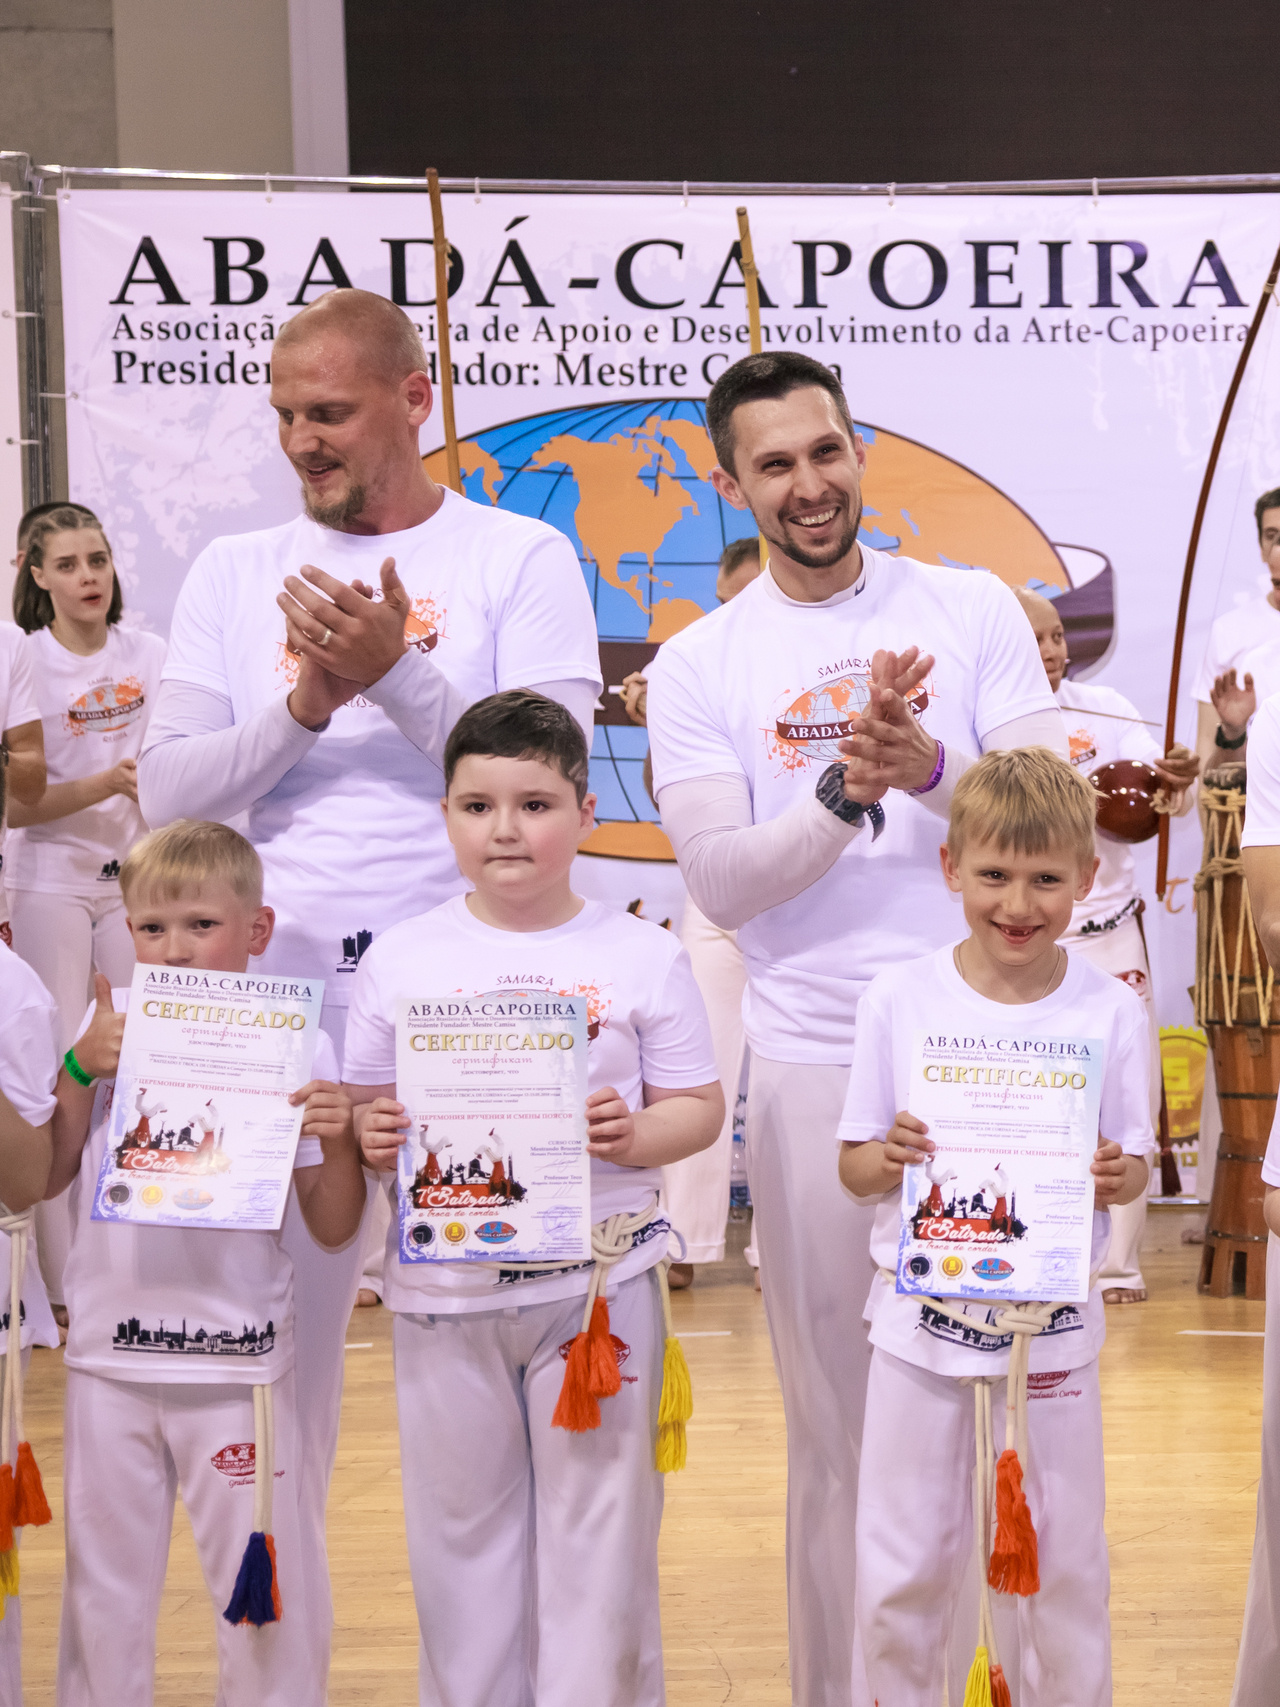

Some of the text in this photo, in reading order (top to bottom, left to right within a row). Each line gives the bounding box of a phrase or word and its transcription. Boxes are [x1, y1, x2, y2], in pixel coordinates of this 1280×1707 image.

[109, 215, 1250, 310] ABADÁ-CAPOEIRA
[112, 312, 276, 348] Associaçã
[482, 315, 520, 343] de
[532, 315, 632, 352] Apoio
[643, 325, 659, 343] e
[671, 315, 962, 344] Desenvolvimento
[974, 315, 1010, 344] da
[1022, 315, 1250, 351] Arte-Capoeira
[554, 352, 688, 387] Mestre
[817, 658, 872, 679] SAMARA
[145, 970, 314, 998] ABADÁ-CAPOEIRA
[496, 974, 554, 986] SAMARA
[140, 998, 307, 1032] CERTIFICADO
[407, 1001, 576, 1015] ABADÁ-CAPOEIRA
[409, 1032, 574, 1051] CERTIFICADO
[923, 1034, 1090, 1055] ABADÁ-CAPOEIRA
[922, 1051, 954, 1060] Presidente
[954, 1053, 985, 1061] Fundador:
[1007, 1056, 1029, 1064] Camisa
[922, 1062, 1087, 1091] CERTIFICADO
[427, 1186, 506, 1207] Batizado
[926, 1217, 1007, 1244] Batizado
